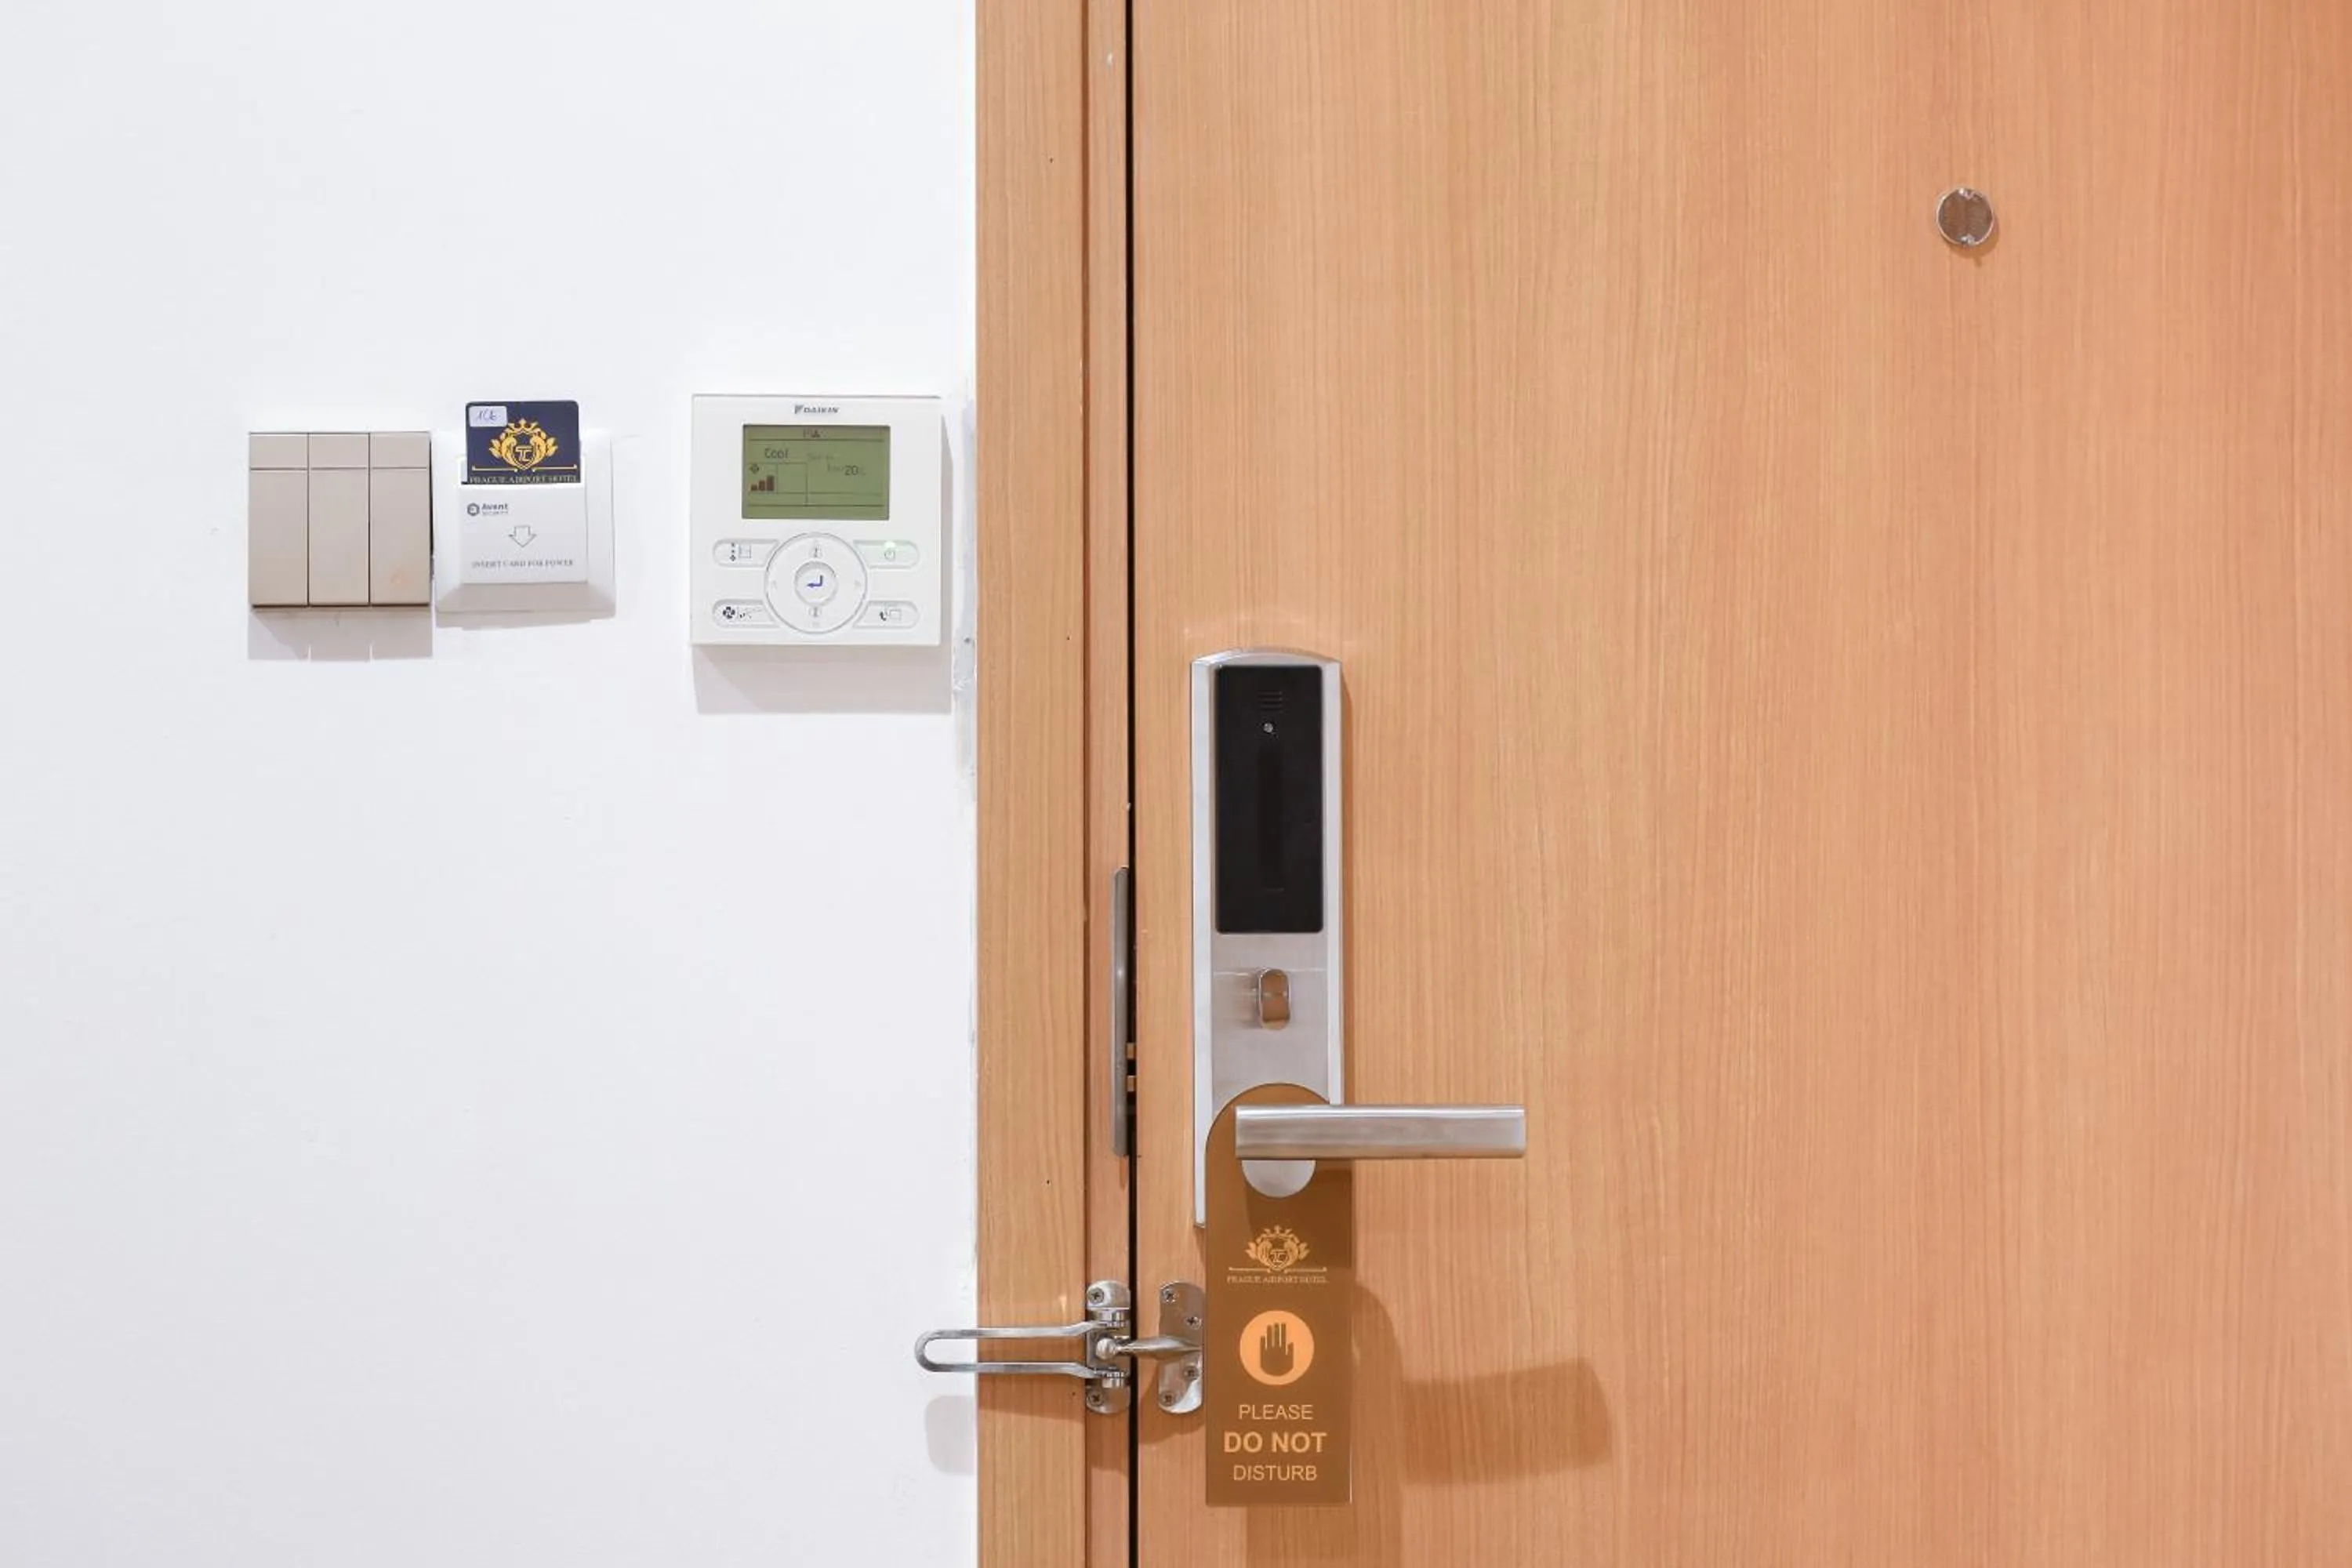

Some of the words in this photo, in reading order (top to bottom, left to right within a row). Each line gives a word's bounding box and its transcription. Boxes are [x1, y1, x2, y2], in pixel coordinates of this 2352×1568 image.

[764, 448, 789, 459] Cool
[1239, 1404, 1313, 1420] PLEASE
[1224, 1431, 1263, 1453] DO
[1272, 1431, 1327, 1453] NOT
[1233, 1465, 1318, 1481] DISTURB
